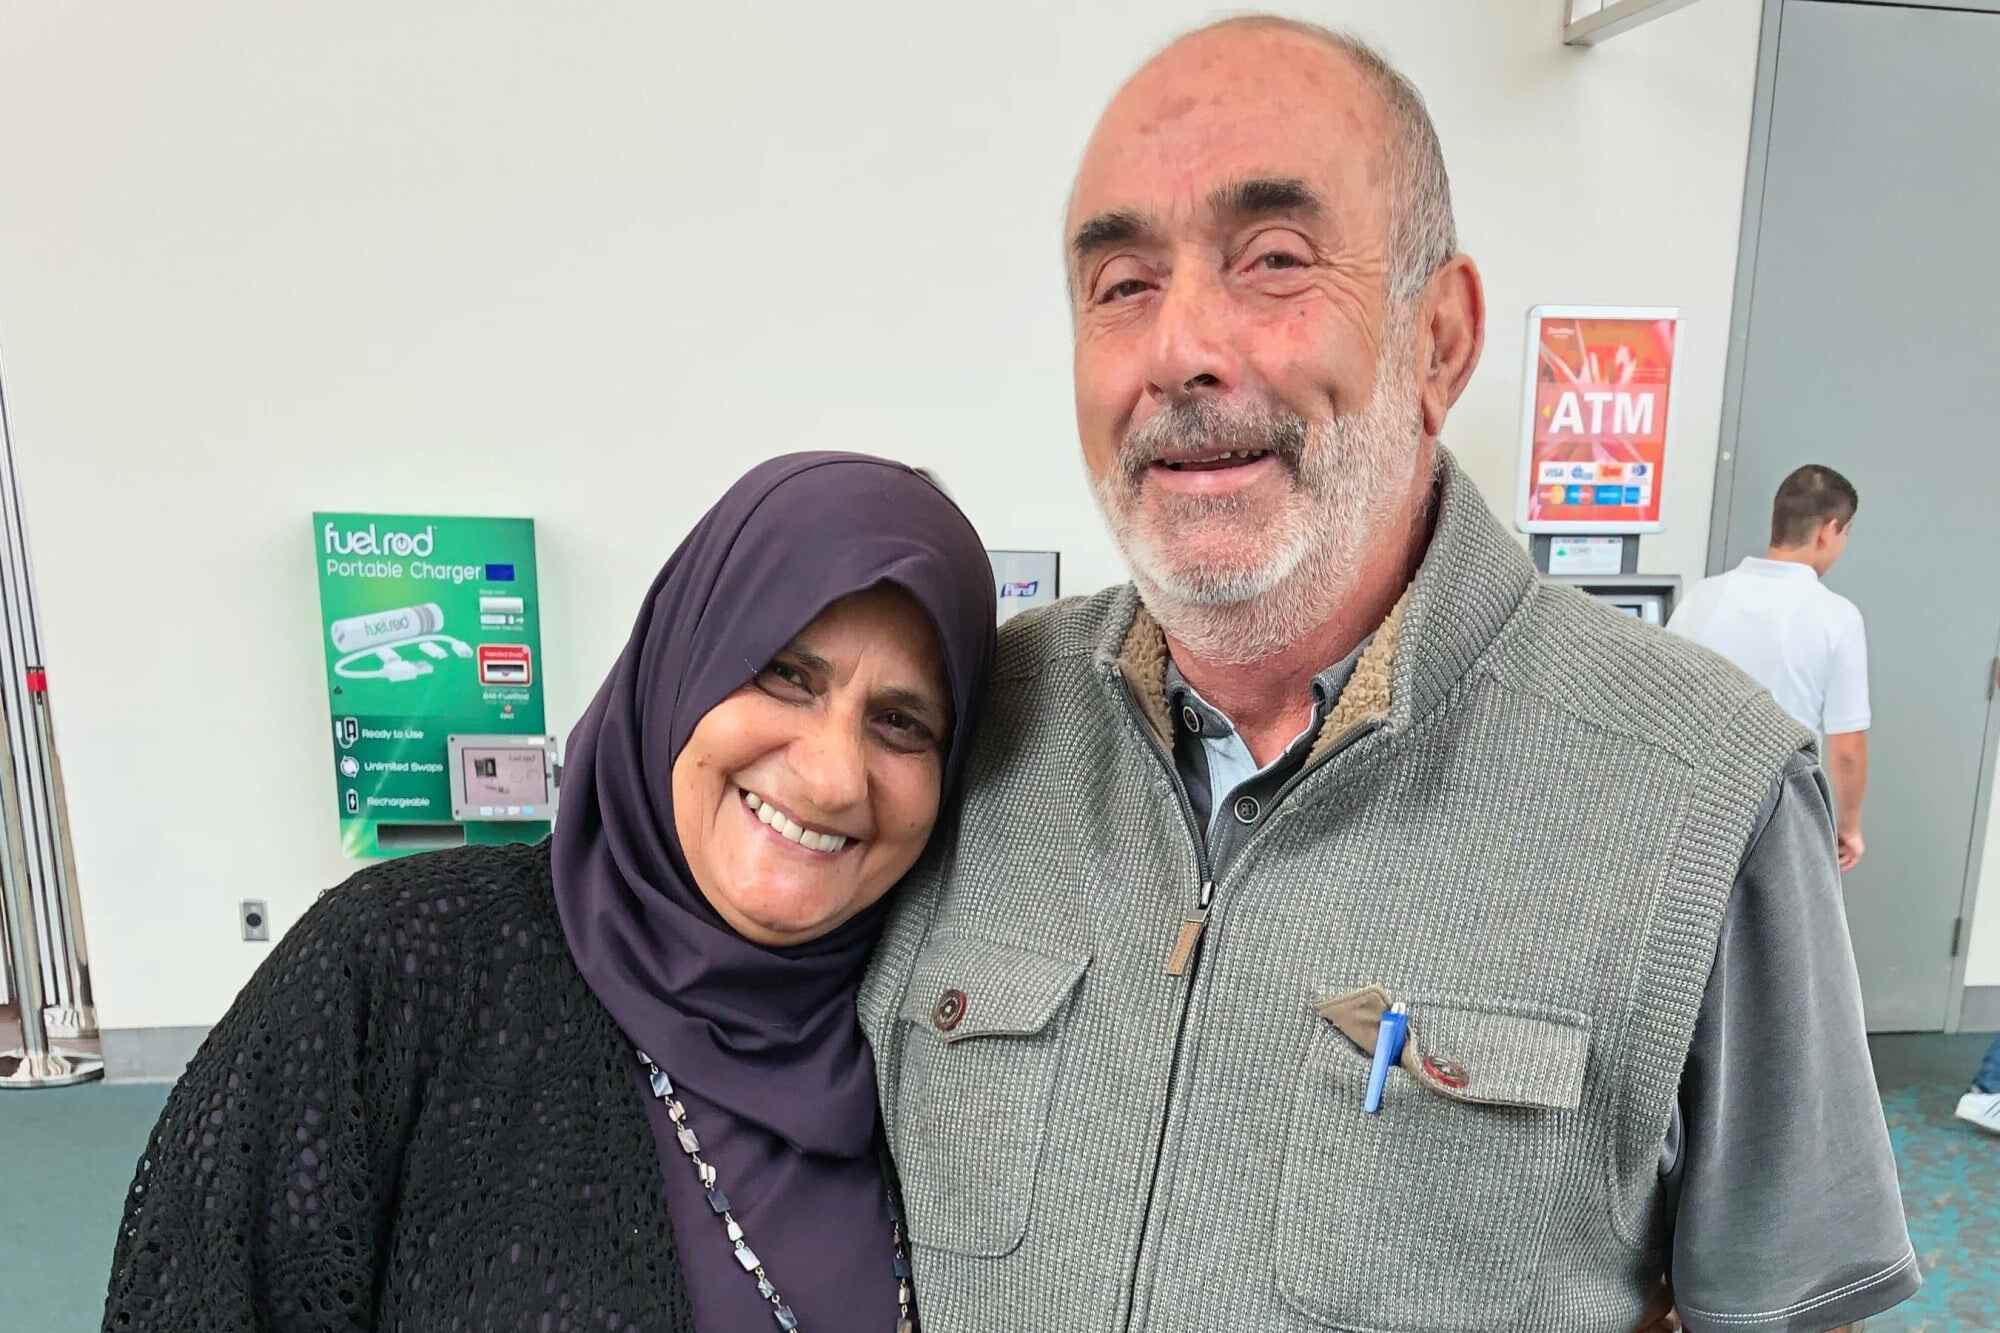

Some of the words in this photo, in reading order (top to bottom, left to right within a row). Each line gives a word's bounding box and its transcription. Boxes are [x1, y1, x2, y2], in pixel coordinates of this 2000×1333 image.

[1548, 391, 1655, 434] ATM
[327, 559, 403, 578] Portable
[410, 561, 481, 585] Charger
[362, 729, 392, 740] Ready
[393, 730, 403, 739] to
[404, 730, 424, 739] Use
[364, 762, 409, 772] Unlimited
[410, 762, 444, 773] Swaps
[366, 797, 430, 808] Rechargeable
